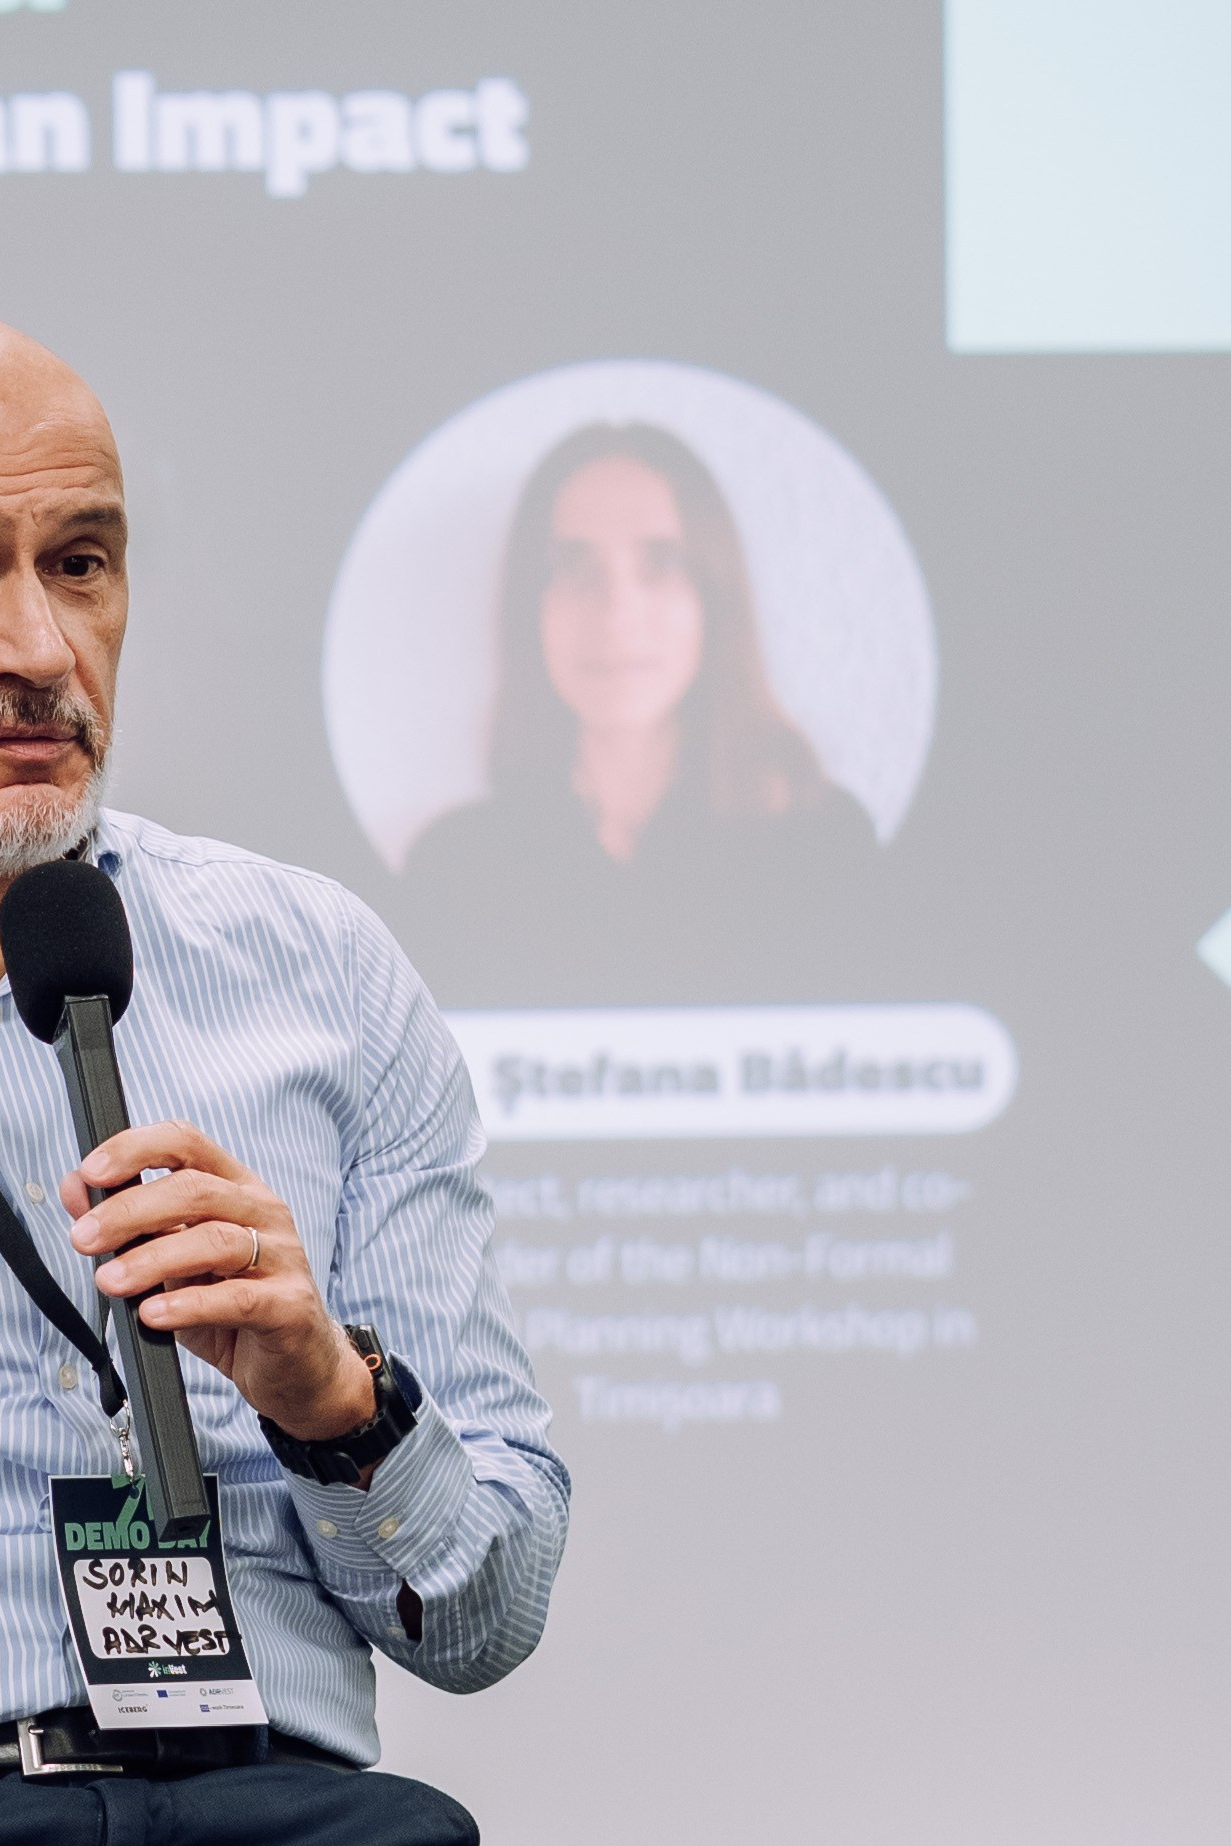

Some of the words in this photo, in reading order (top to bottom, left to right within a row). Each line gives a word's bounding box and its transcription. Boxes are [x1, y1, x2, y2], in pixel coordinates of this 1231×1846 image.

[113, 71, 528, 197] Impact
[813, 1165, 898, 1212] and
[566, 1236, 614, 1285] of
[619, 1237, 694, 1284] the
[713, 1304, 929, 1359] Workshop
[64, 1520, 151, 1551] DEMO
[83, 1558, 188, 1590] SORIN
